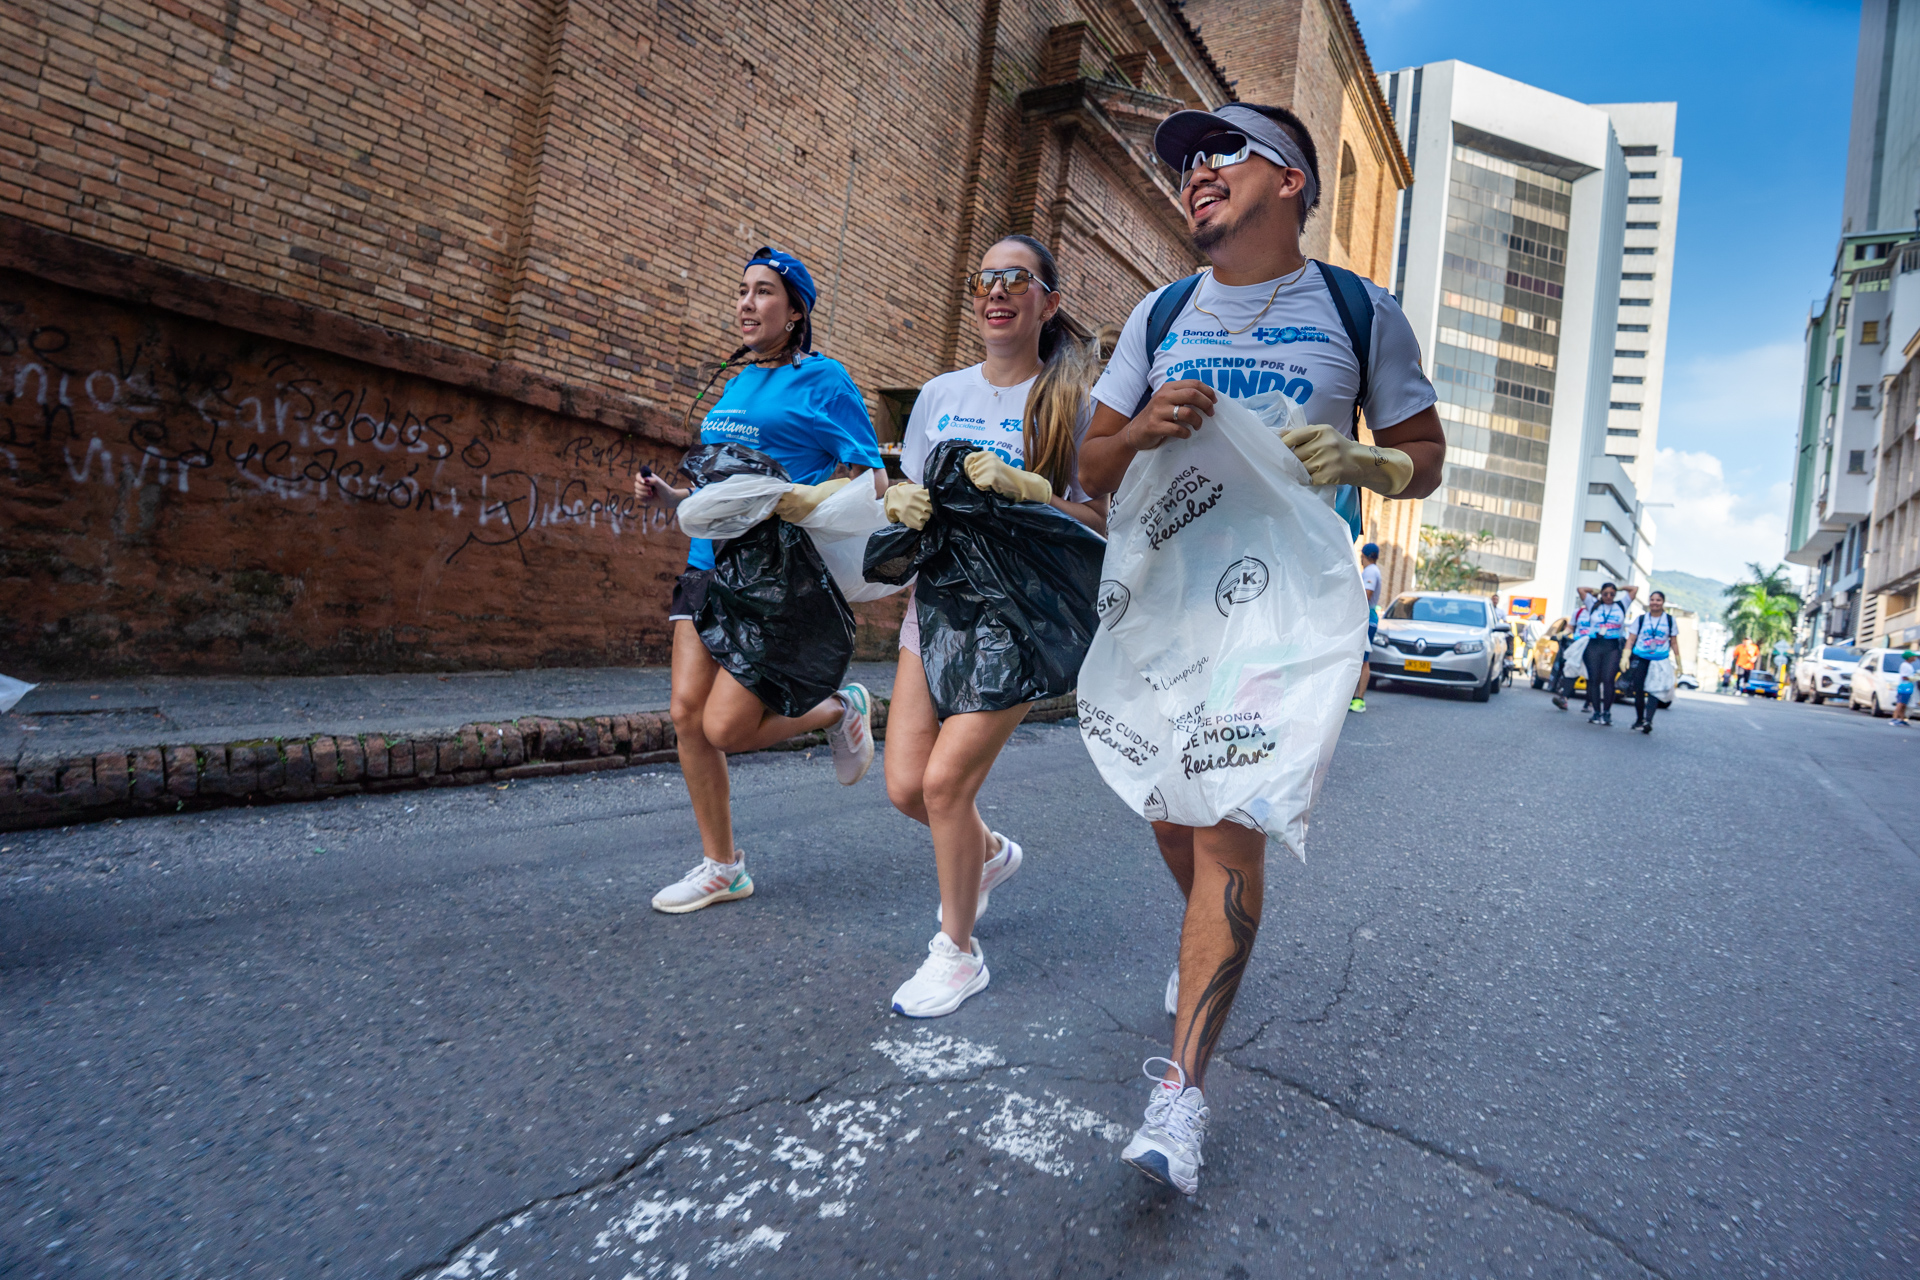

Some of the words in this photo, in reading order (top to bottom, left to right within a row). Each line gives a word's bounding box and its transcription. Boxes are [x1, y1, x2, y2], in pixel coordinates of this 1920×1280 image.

[1181, 337, 1233, 346] Occidente
[1183, 329, 1213, 338] Banco
[1216, 329, 1229, 337] de
[1166, 357, 1256, 377] CORRIENDO
[1260, 360, 1285, 371] POR
[1290, 364, 1308, 376] UN
[950, 421, 986, 432] Occidente
[953, 415, 975, 424] Banco
[976, 417, 985, 425] de
[996, 440, 1013, 451] POR
[1140, 505, 1157, 525] QUE
[1167, 465, 1199, 497] PONGA
[1145, 513, 1163, 538] DE
[1163, 474, 1211, 513] MODA
[1149, 490, 1221, 551] Reciclar
[1077, 698, 1115, 726] ELIGE
[1115, 722, 1159, 757] CUIDAR
[1216, 711, 1263, 725] PONGA
[1203, 723, 1266, 745] MODA
[1087, 725, 1143, 767] planeta
[1181, 743, 1269, 780] Reciclar
